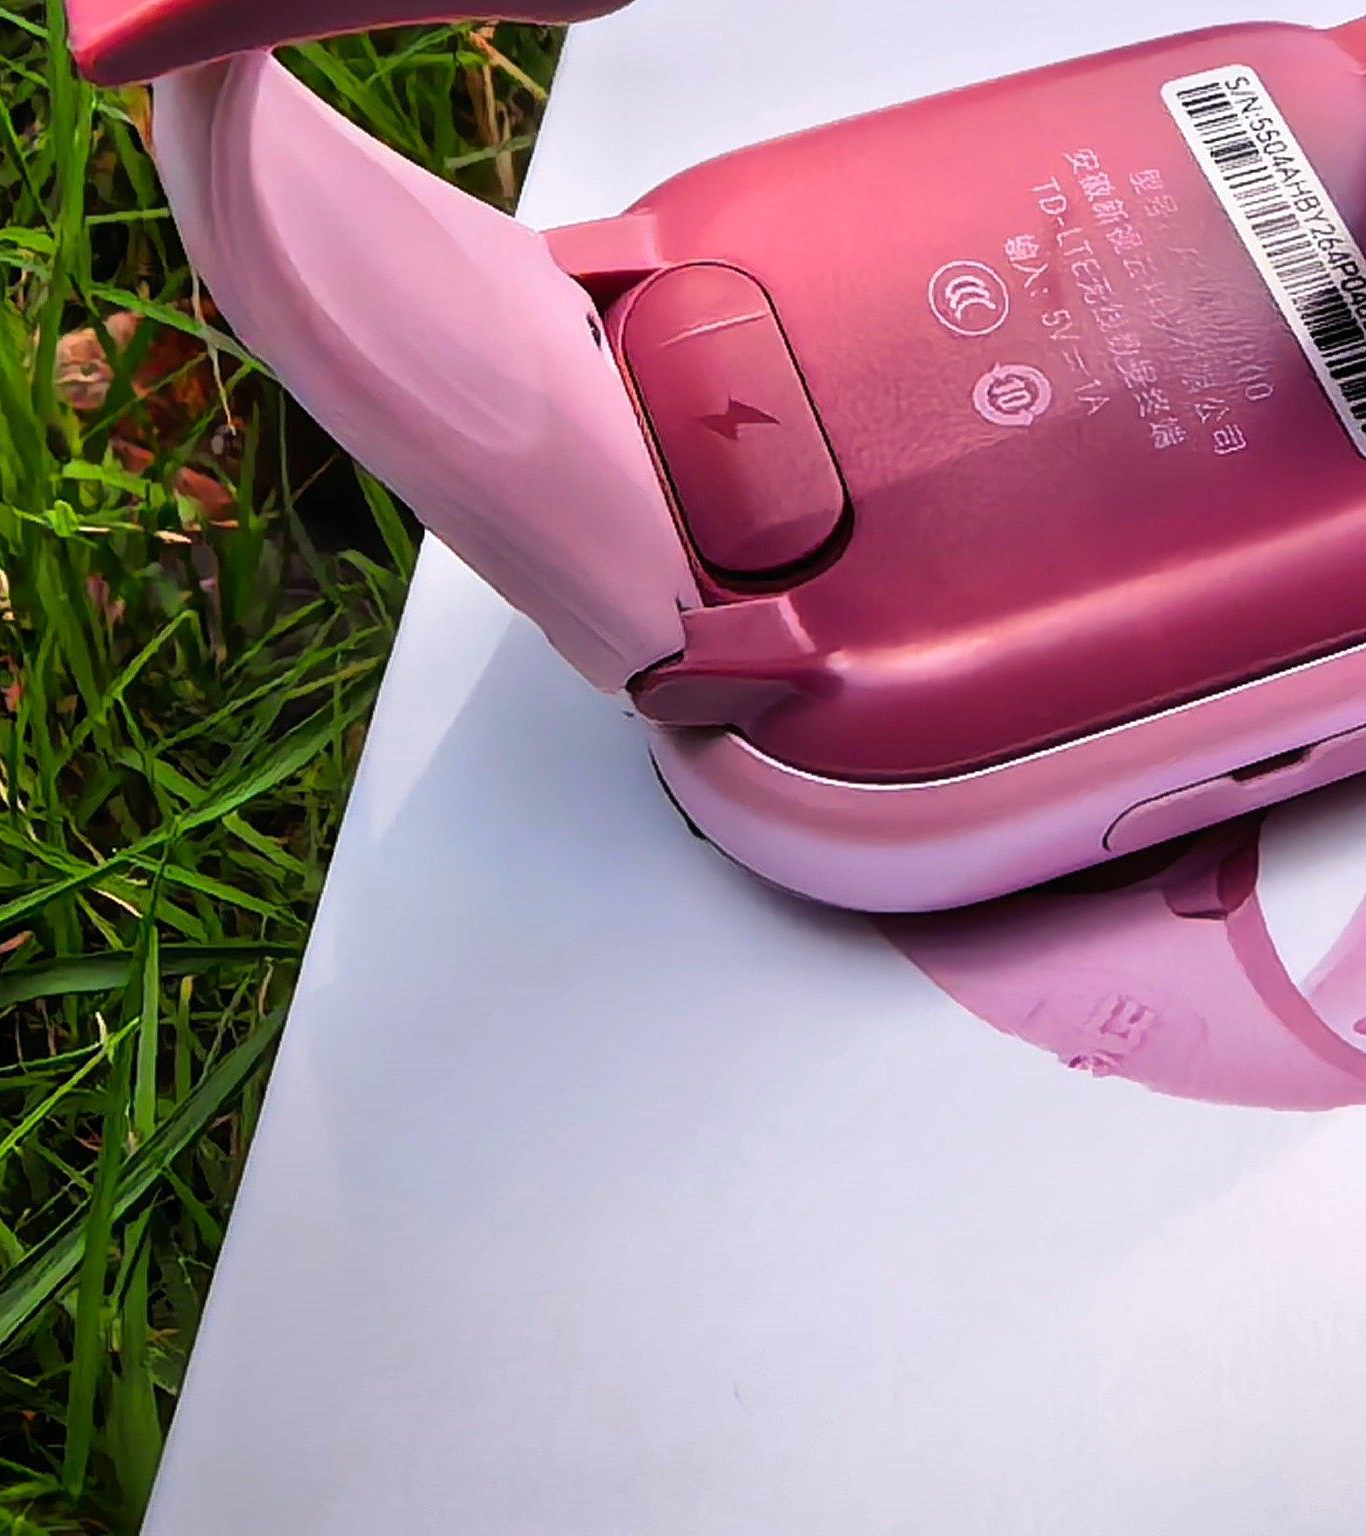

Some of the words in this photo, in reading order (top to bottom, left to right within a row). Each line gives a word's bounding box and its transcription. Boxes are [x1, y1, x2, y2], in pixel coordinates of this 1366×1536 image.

[1063, 147, 1247, 455] 安徽新视云公司
